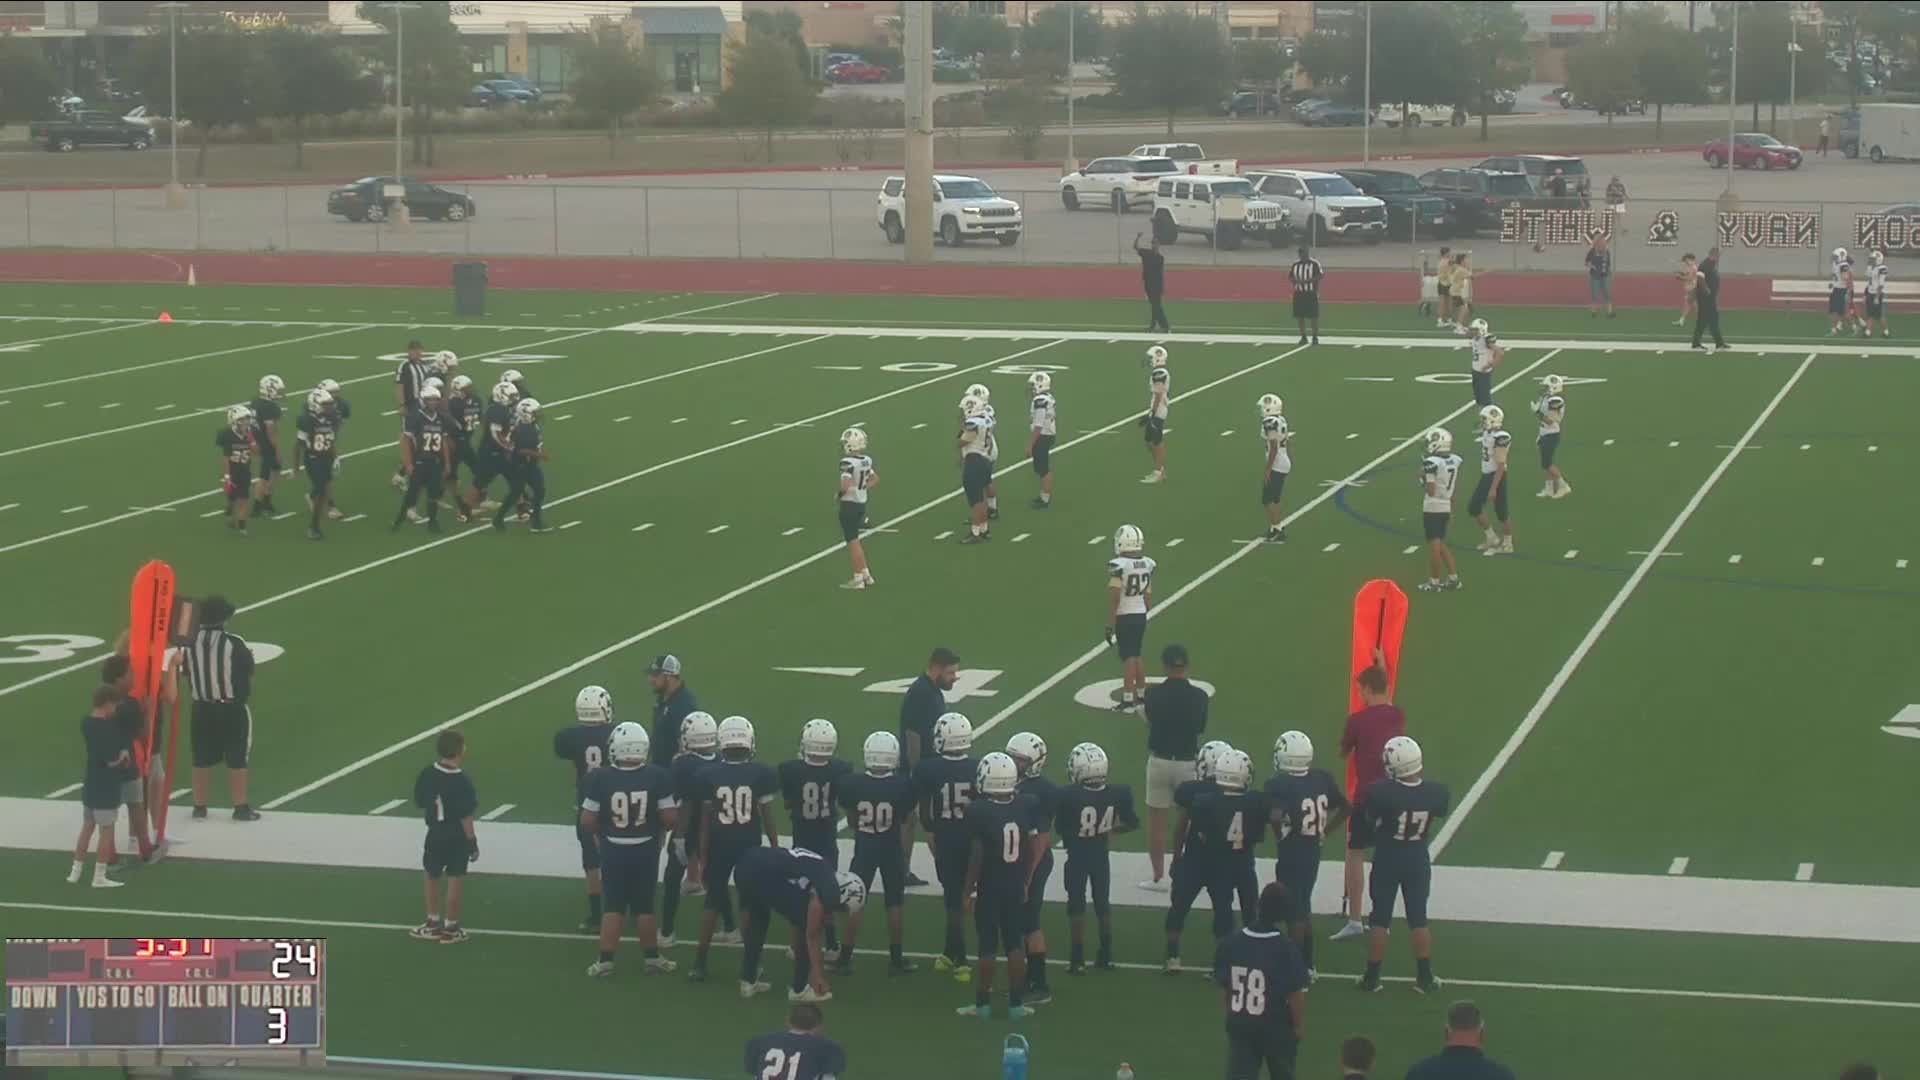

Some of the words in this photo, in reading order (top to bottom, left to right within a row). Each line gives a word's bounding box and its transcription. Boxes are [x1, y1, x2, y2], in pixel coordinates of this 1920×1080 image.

[1125, 573, 1151, 598] 82
[434, 794, 445, 822] 1
[611, 790, 648, 829] 97
[716, 786, 753, 825] 30
[802, 781, 831, 820] 81
[857, 800, 893, 833] 20
[940, 782, 971, 819] 15
[1078, 805, 1115, 838] 84
[1226, 811, 1244, 850] 4
[1393, 810, 1429, 841] 17
[1003, 821, 1020, 863] 0
[1231, 966, 1266, 1015] 58
[762, 1048, 801, 1080] 21
